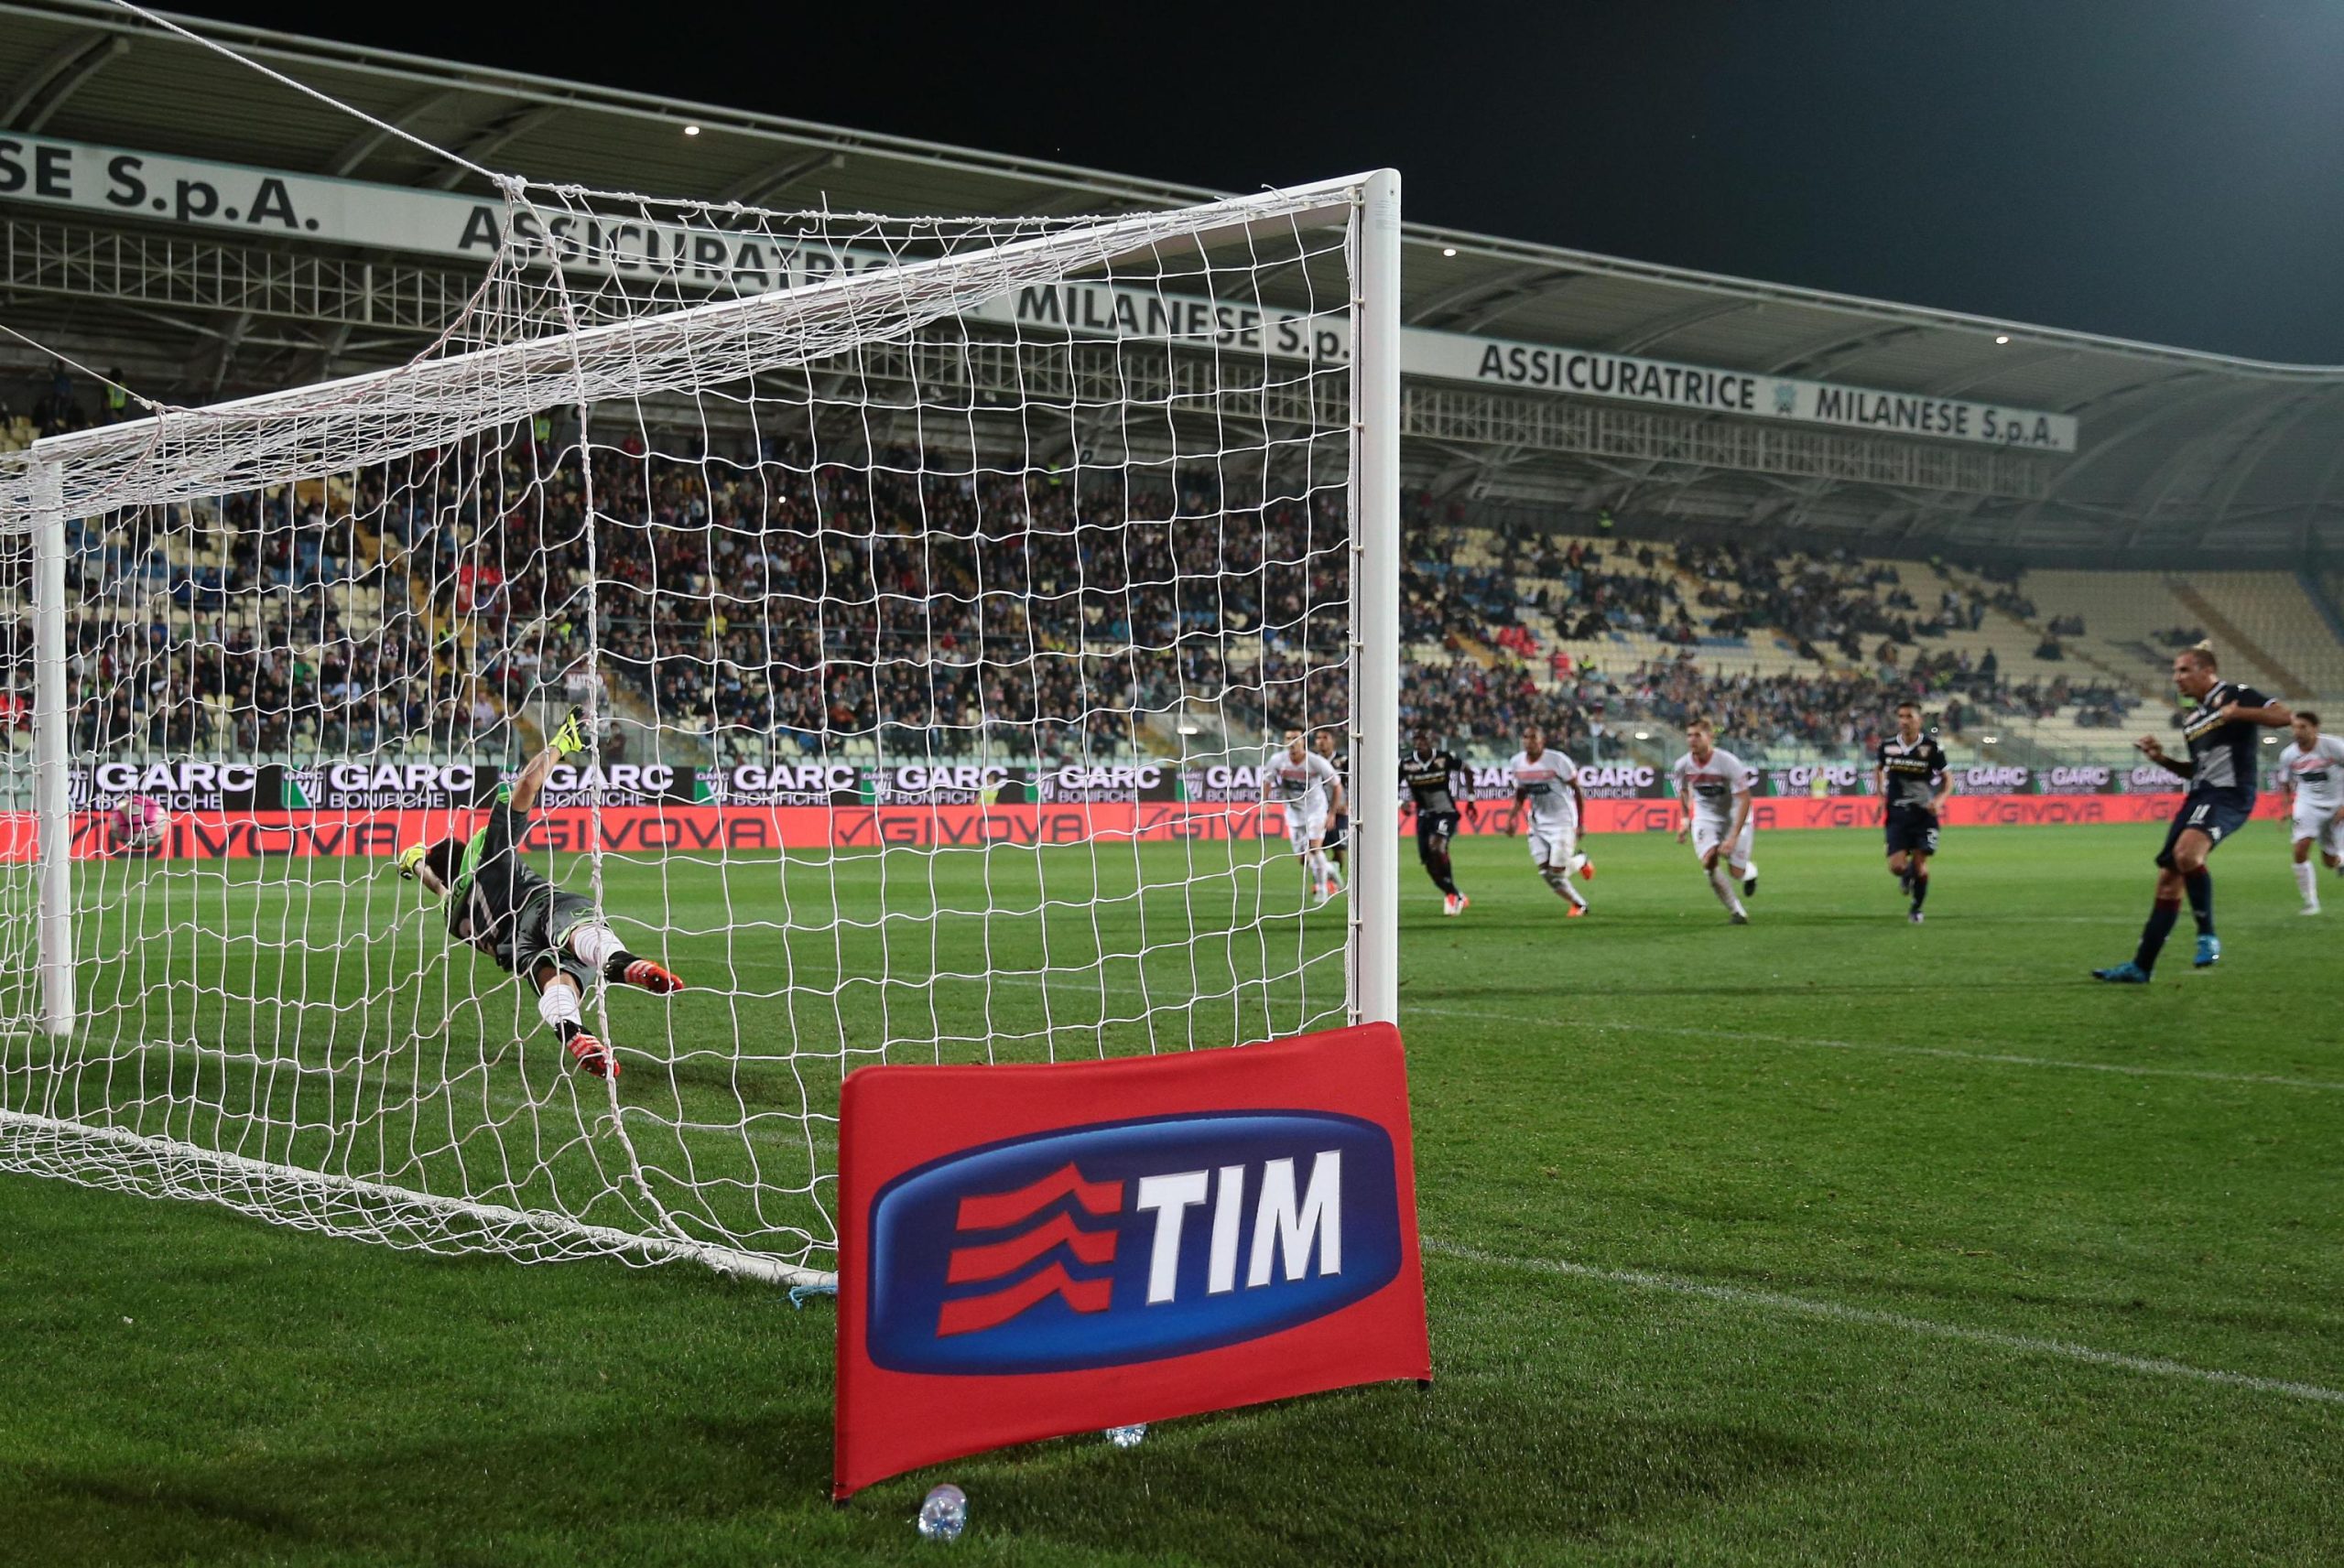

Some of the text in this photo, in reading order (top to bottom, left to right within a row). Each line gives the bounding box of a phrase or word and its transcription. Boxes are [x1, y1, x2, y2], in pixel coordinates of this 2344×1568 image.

[105, 155, 320, 232] S.p.A.
[459, 205, 895, 288] ASSICURATRI
[1017, 284, 1262, 349] MILANESE
[1477, 343, 2061, 448] ASSICURATRICE MILANESE S.p.A.
[96, 762, 255, 792] GARC
[331, 763, 474, 792] GARC
[545, 763, 674, 792] GARC
[733, 764, 855, 790] GARC
[896, 764, 1008, 790] GARC
[1058, 764, 1161, 789] GARC
[1460, 765, 1515, 787] GAR
[1577, 765, 1655, 787] GARC
[1967, 765, 2028, 786] GARC
[2051, 765, 2111, 786] GARC
[330, 792, 446, 809] BONIFICHE
[542, 792, 646, 807] BONIICHE
[896, 790, 976, 805] BONIFICH
[525, 817, 765, 851] GIVOVA
[882, 814, 1082, 844] GIVOVA
[1136, 1149, 1341, 1306] TIM
